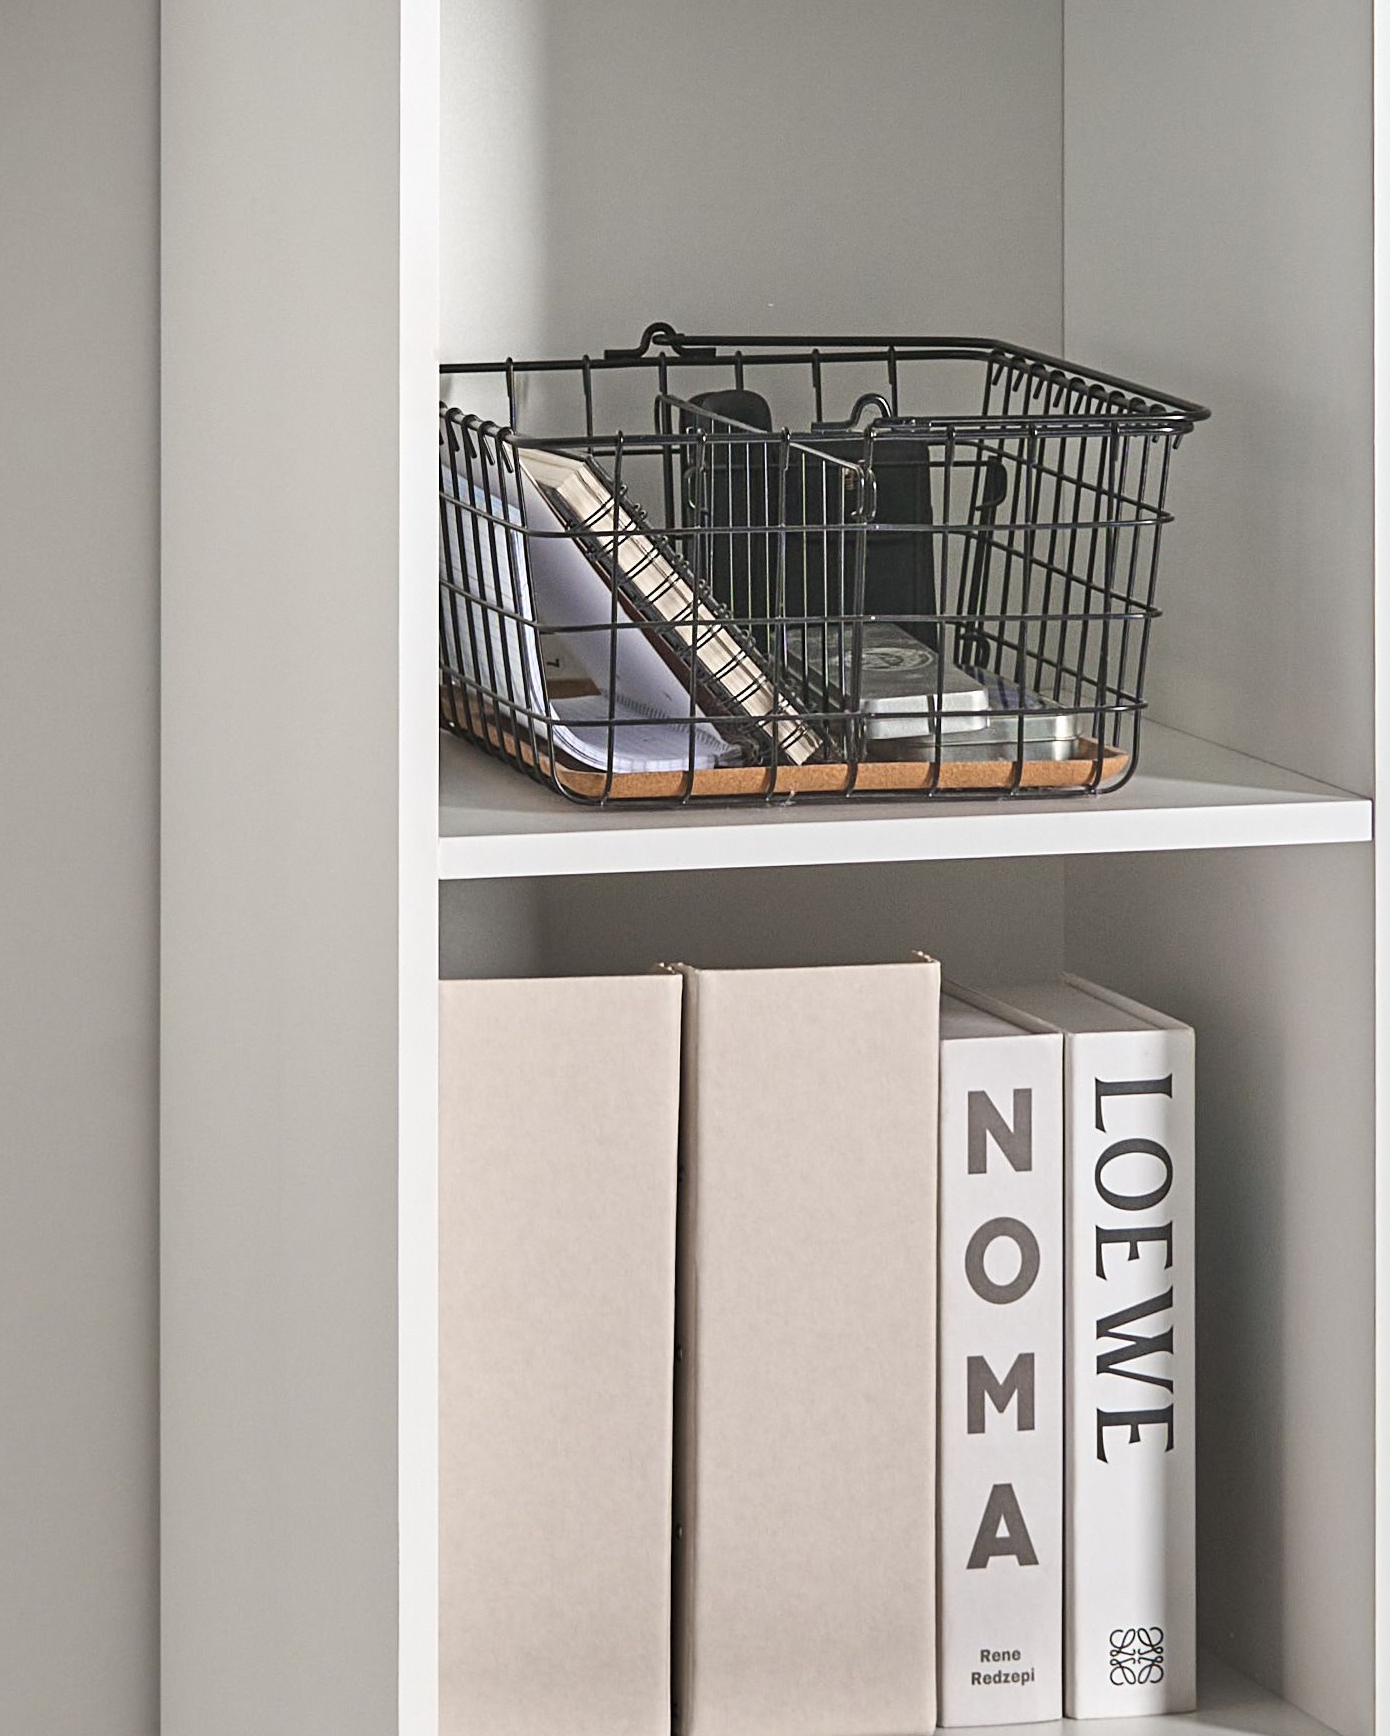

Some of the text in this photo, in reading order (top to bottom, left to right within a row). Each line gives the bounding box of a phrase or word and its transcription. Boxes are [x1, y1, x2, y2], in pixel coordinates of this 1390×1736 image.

[965, 1088, 1040, 1569] NOMA
[1093, 1073, 1174, 1464] LOEWE
[971, 1667, 1035, 1686] Redzepi
[979, 1648, 1022, 1663] Rene
